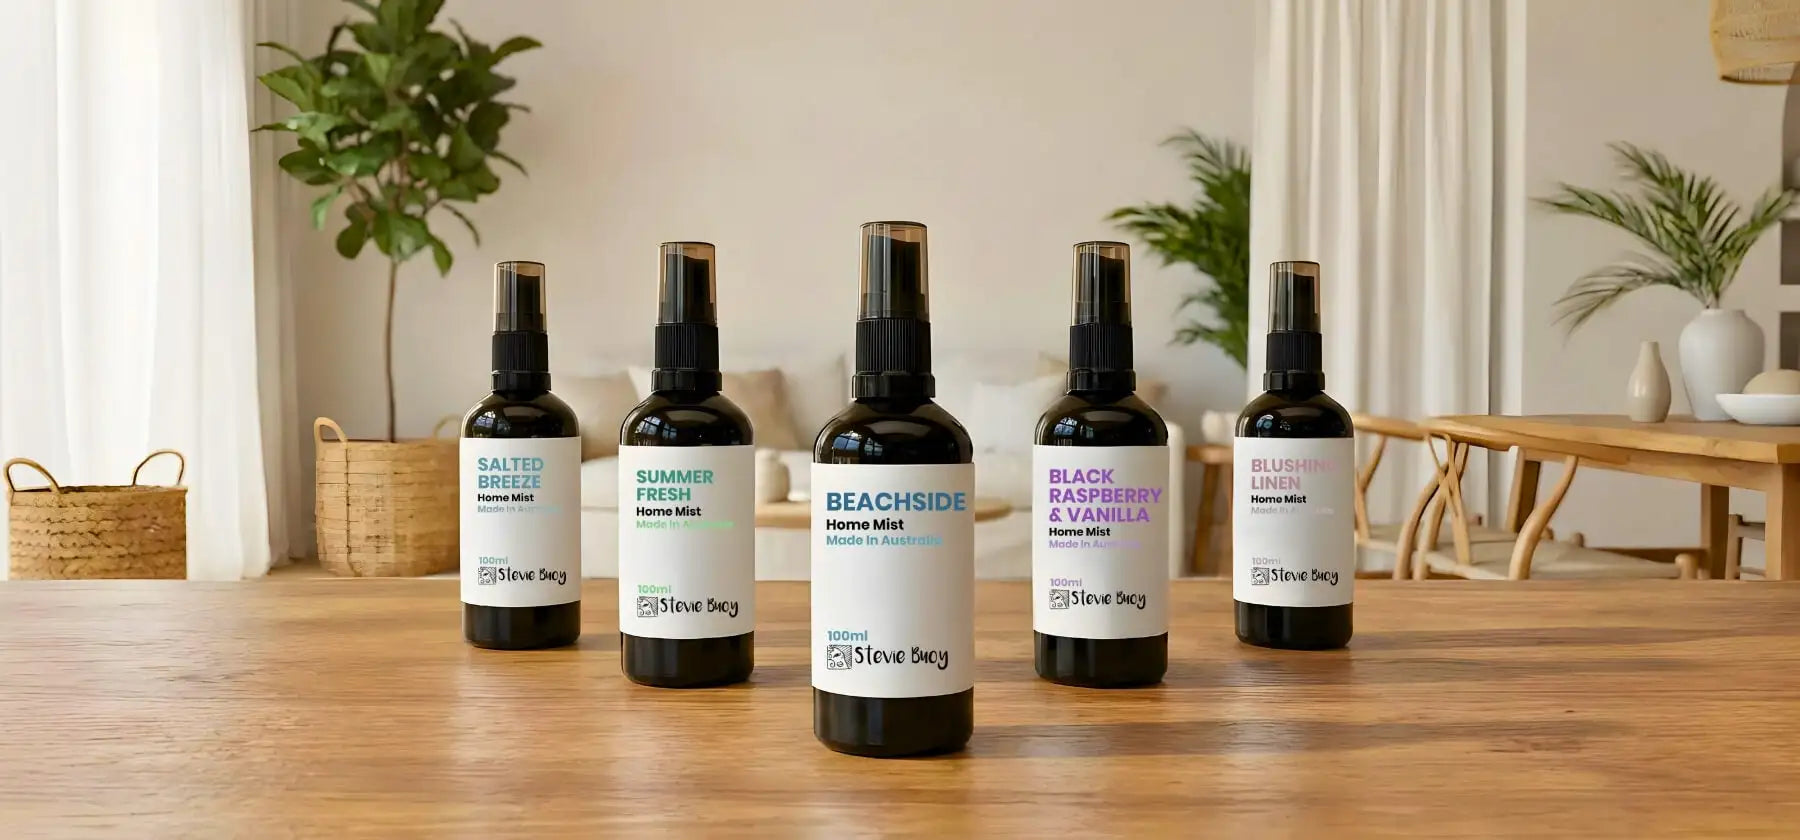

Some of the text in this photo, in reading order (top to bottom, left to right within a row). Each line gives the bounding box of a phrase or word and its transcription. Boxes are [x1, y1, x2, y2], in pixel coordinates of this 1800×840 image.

[477, 457, 544, 472] SALTED
[478, 474, 541, 489] BREEZE
[636, 469, 714, 484] SUMMER
[1049, 468, 1115, 484] BLACK
[1251, 476, 1301, 490] LINEN
[477, 492, 535, 502] Home Mist
[636, 487, 692, 501] FRESH
[1049, 487, 1162, 504] RASPBERRY
[1250, 494, 1307, 504] Home Mist
[477, 504, 505, 513] Made
[506, 504, 516, 513] In
[826, 492, 967, 512] BEACHSIDE
[636, 506, 702, 517] Home Mist
[1048, 507, 1150, 523] & VANILLA
[1250, 506, 1278, 515] Made
[636, 519, 668, 529] Made
[826, 518, 904, 531] Home Mist
[1048, 526, 1111, 537] Home Mist
[826, 535, 943, 546] Made In Australia
[1048, 540, 1079, 549] Made
[1080, 540, 1091, 549] In
[479, 556, 508, 565] 100ml
[1251, 557, 1281, 566] 100ml
[498, 566, 567, 586] Stevie Buoy
[1270, 568, 1339, 587] Stevie Buoy
[637, 584, 672, 594] 100ml
[1050, 578, 1083, 588] 100ml
[1071, 589, 1147, 610] Stevie Buoy
[660, 596, 739, 618] Stevie Buoy
[827, 630, 868, 642] 100ml
[854, 644, 949, 670] Stevie Buoy
